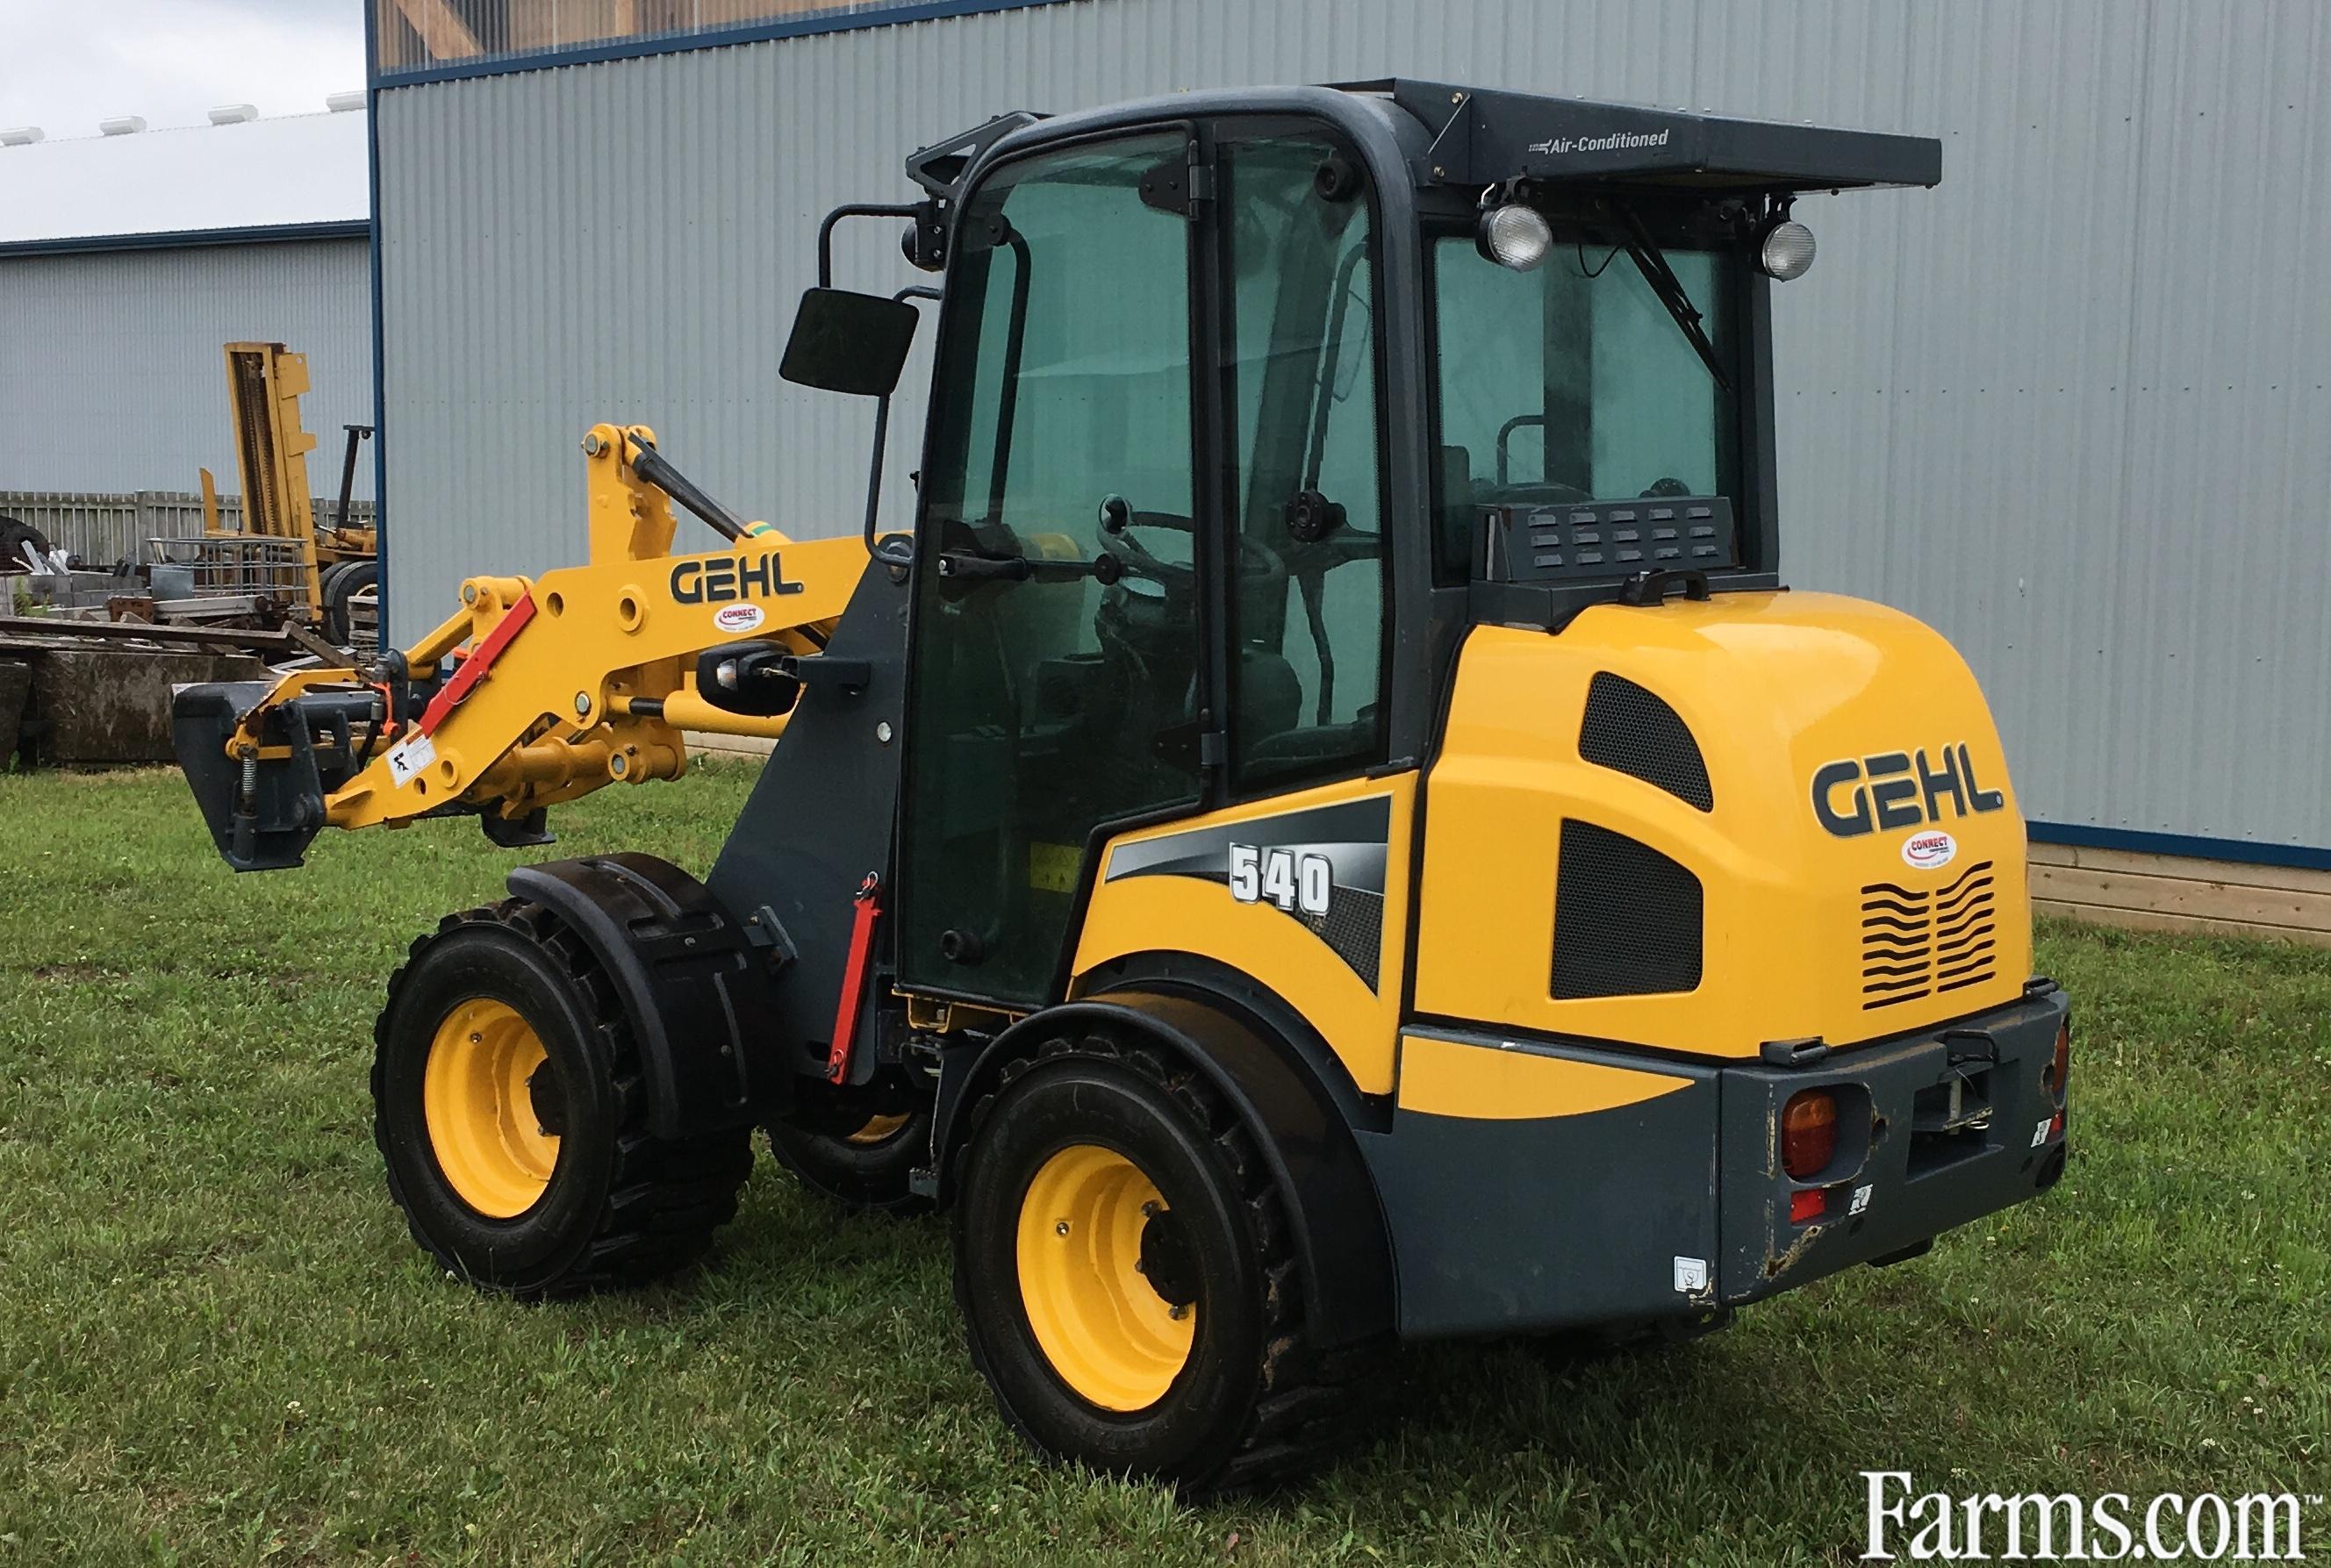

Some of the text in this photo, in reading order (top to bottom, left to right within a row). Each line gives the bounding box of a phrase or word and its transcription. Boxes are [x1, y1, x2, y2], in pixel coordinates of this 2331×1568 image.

[1550, 129, 1669, 154] Air-Conditioned
[671, 552, 804, 604] GEHL
[722, 608, 757, 619] CONNECT
[1811, 741, 2004, 839] GEHL
[1911, 836, 1947, 851] CONNECT
[1230, 842, 1333, 916] 540
